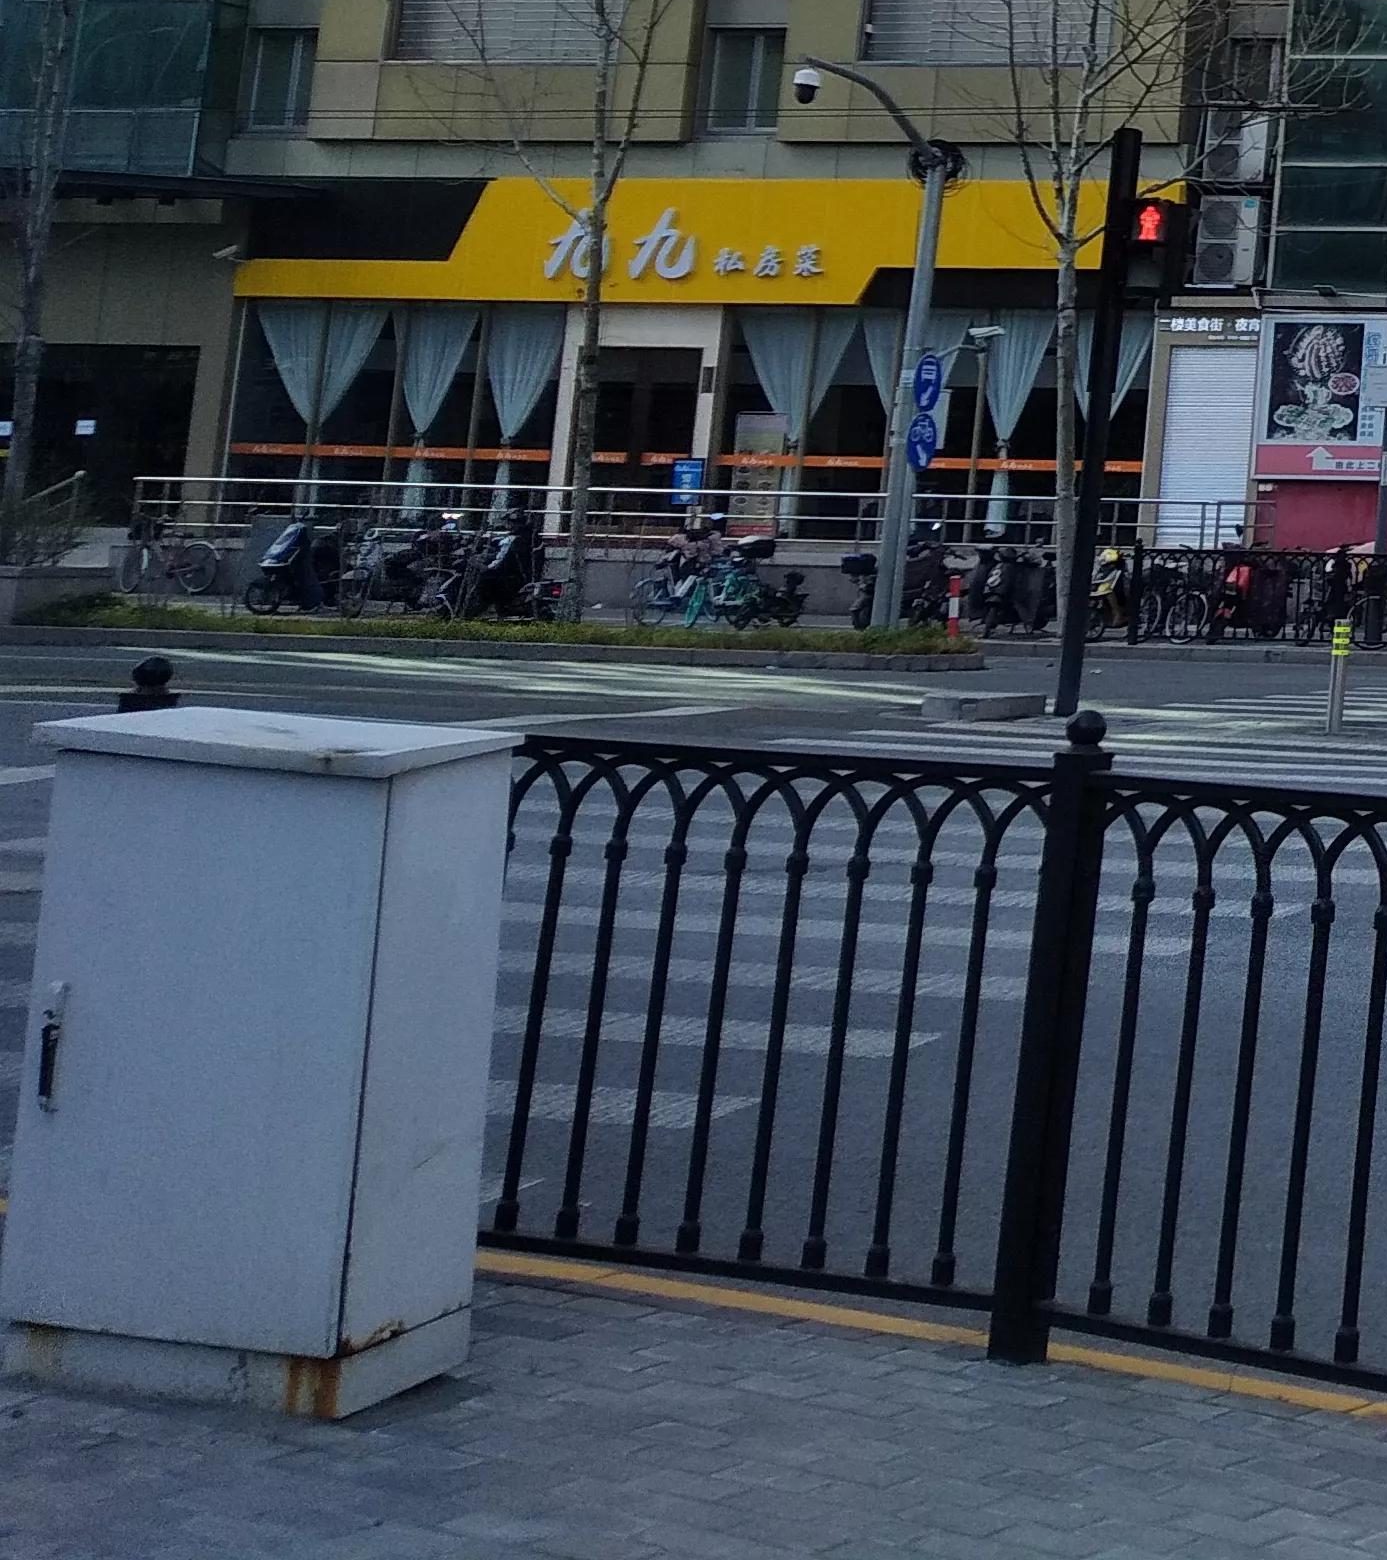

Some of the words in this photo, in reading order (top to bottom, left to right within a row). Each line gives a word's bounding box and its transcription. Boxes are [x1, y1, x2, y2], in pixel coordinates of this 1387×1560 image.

[713, 243, 825, 278] 私房菜
[1334, 460, 1382, 471] 由此上二
